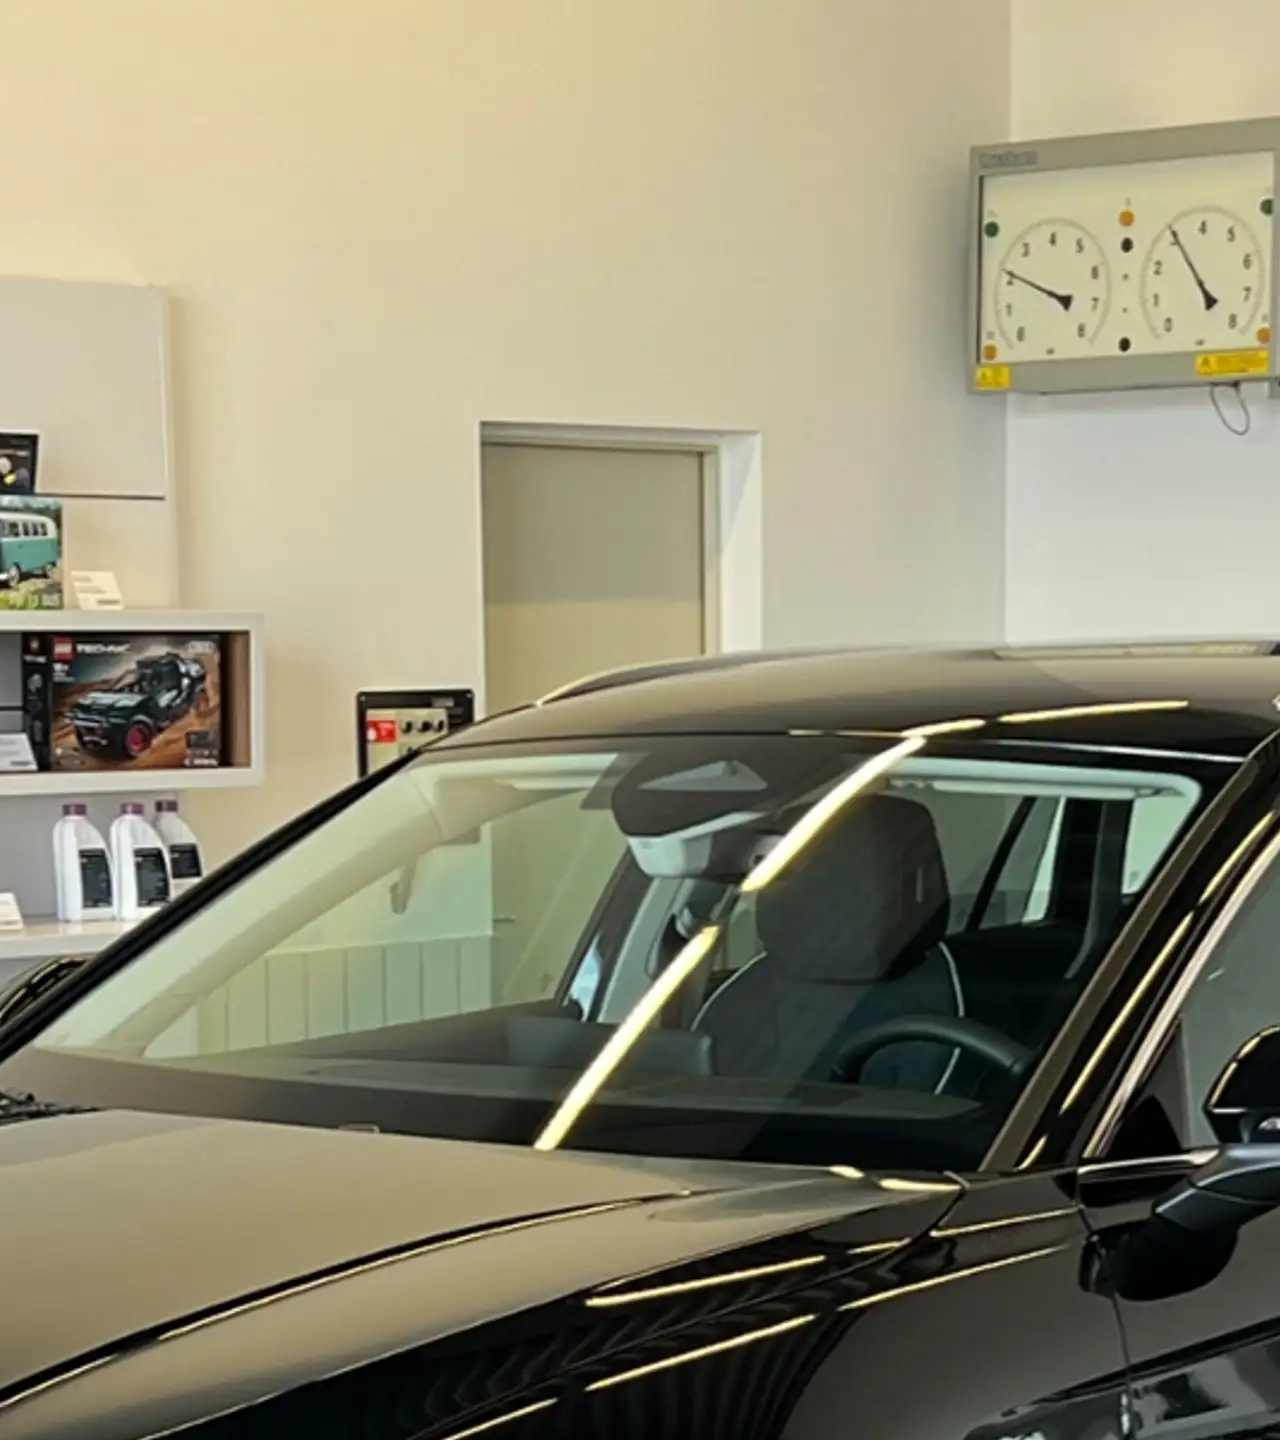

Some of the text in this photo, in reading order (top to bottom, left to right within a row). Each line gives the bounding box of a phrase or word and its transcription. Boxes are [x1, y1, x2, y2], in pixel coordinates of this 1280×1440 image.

[1198, 219, 1208, 236] 4
[1227, 226, 1236, 243] 5
[1152, 260, 1163, 276] 2
[1243, 253, 1253, 270] 6
[1242, 285, 1253, 302] 7
